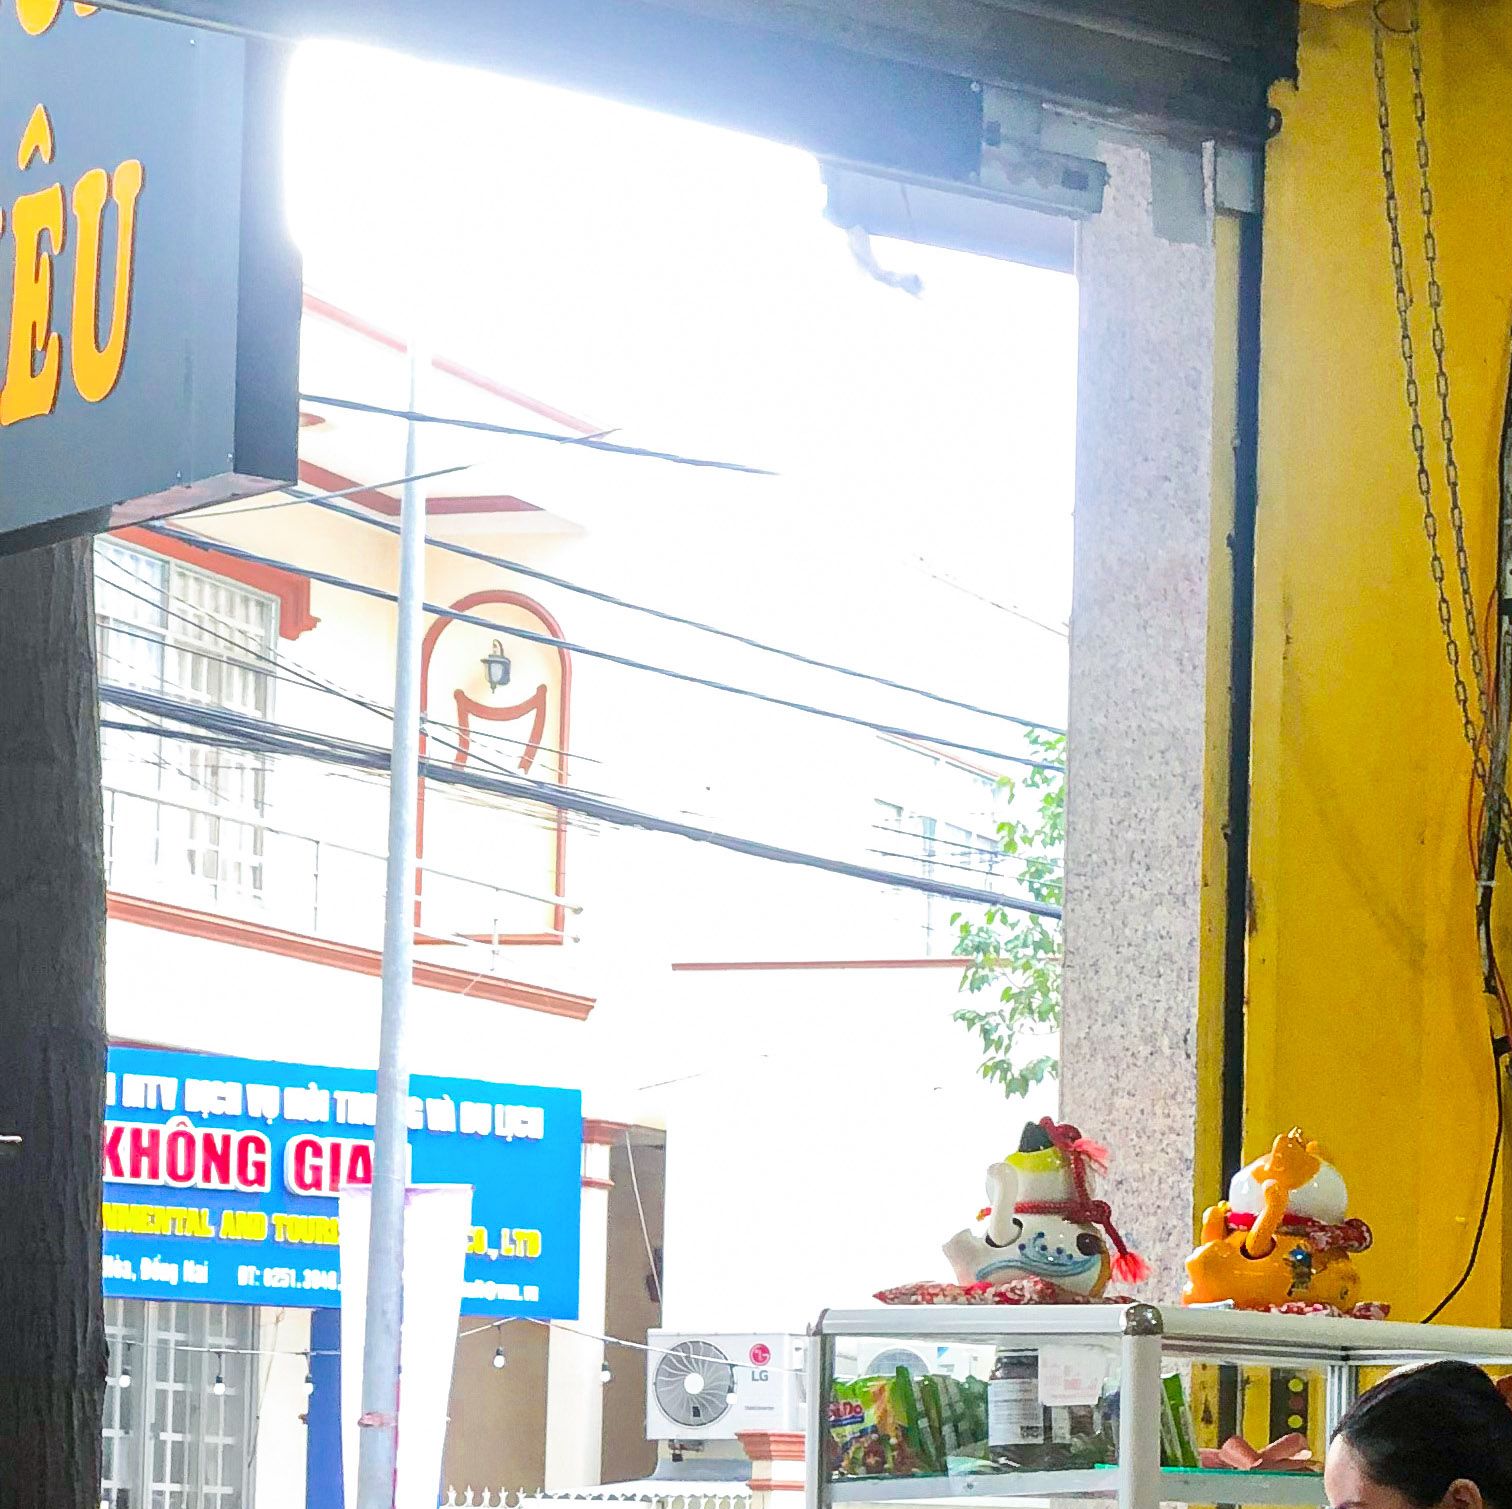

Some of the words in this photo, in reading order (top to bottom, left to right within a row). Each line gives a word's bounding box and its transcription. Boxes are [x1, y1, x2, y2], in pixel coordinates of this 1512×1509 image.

[0, 103, 142, 426] ÊU
[104, 1122, 266, 1187] KHÔNG
[294, 1139, 374, 1192] GIA
[501, 1227, 542, 1258] LTD
[752, 1370, 768, 1381] LG
